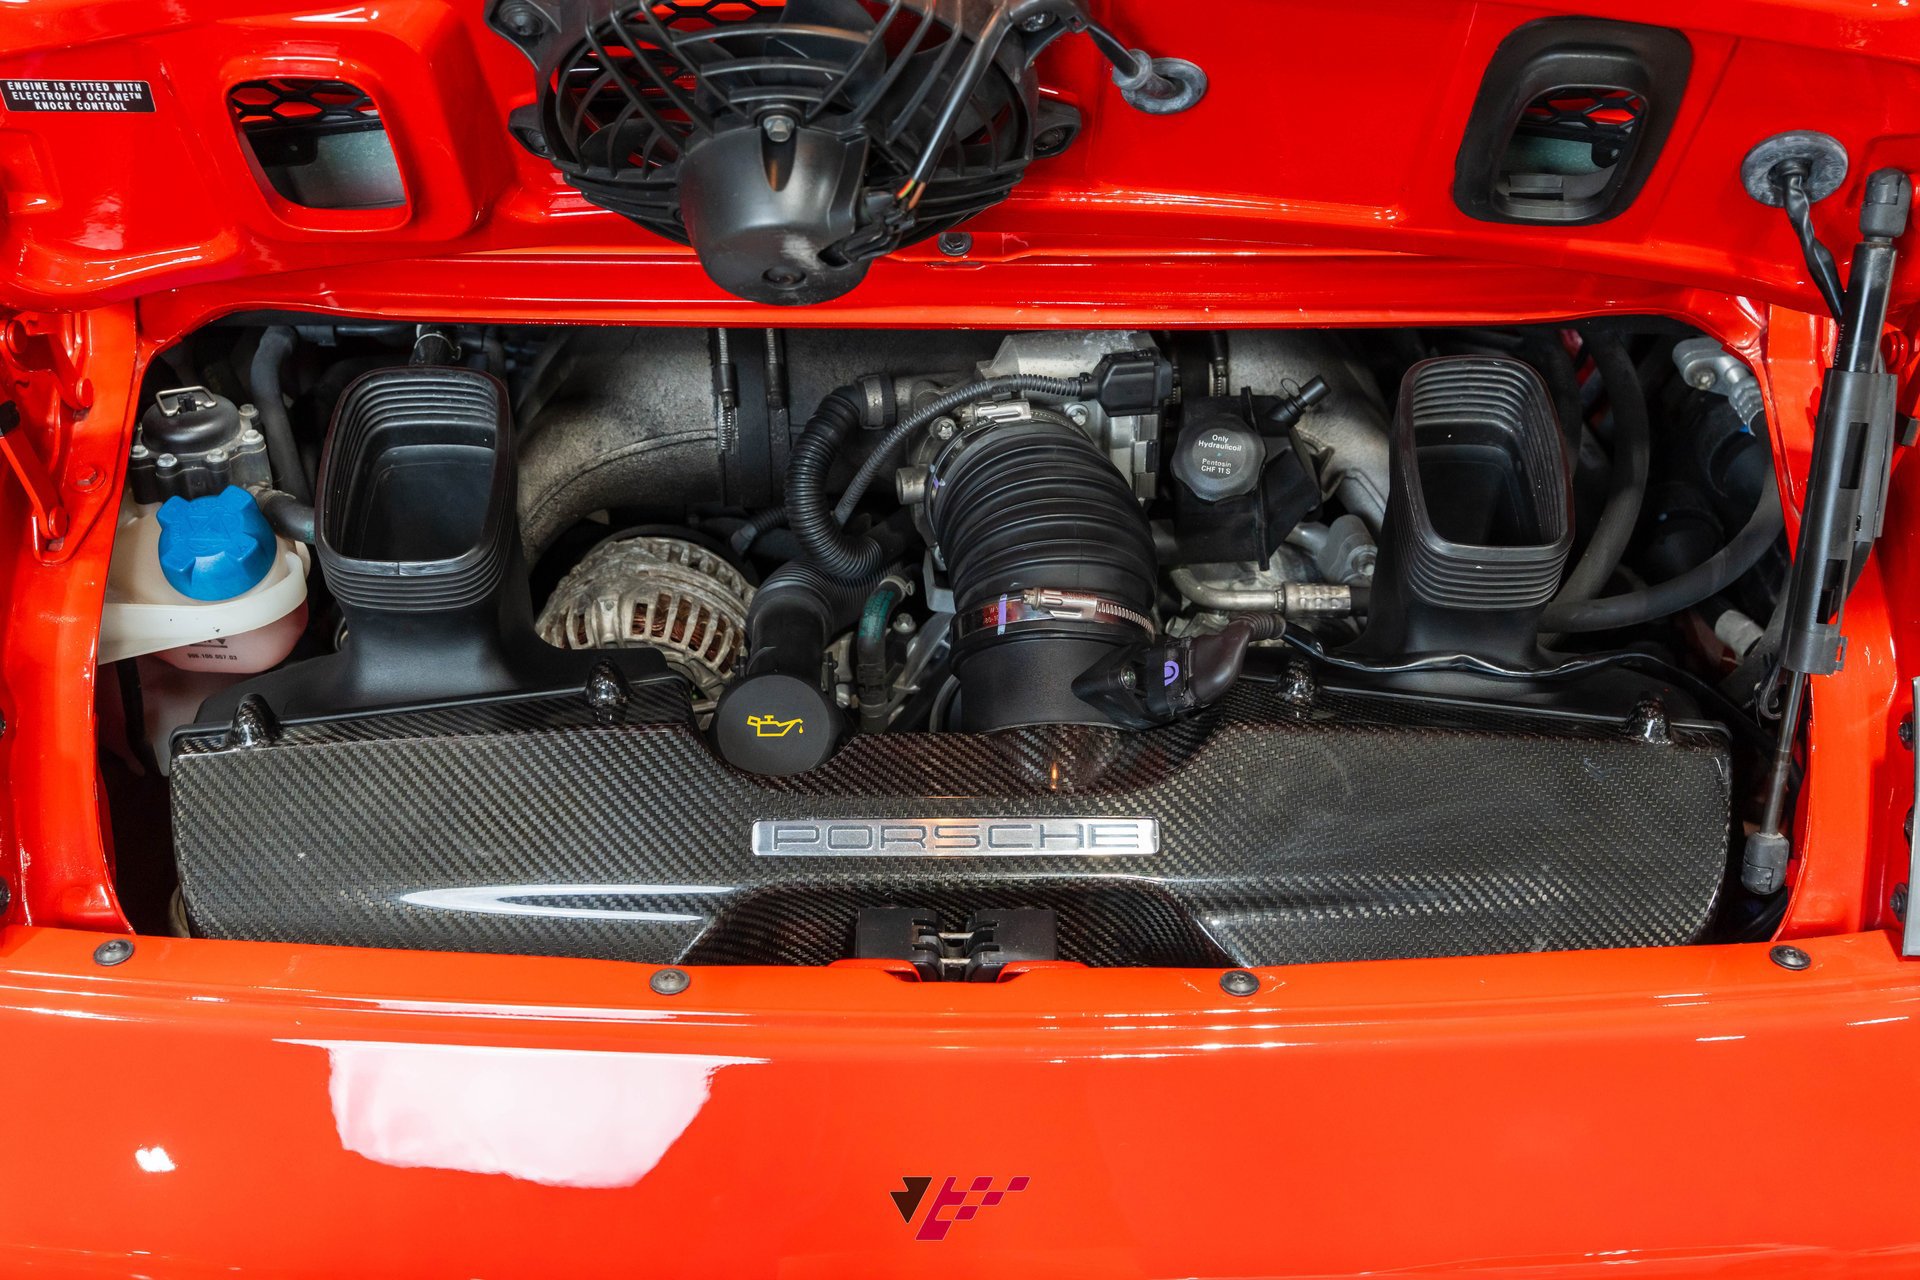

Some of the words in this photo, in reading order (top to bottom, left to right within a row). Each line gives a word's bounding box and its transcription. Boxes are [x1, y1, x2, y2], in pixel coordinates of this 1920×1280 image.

[7, 81, 49, 91] ENGINE
[54, 82, 65, 91] IS
[71, 82, 110, 92] FITTED
[114, 83, 142, 92] WITH
[11, 91, 82, 101] ELECTRONIC
[34, 101, 73, 111] KNOCK
[76, 102, 127, 111] CONTROL
[1212, 434, 1229, 443] Only
[1198, 440, 1242, 452] Hydraulicoil
[1202, 458, 1232, 468] Pentosin
[1201, 465, 1216, 473] CHF
[1225, 467, 1231, 475] S
[772, 823, 1140, 851] PORSCHE
